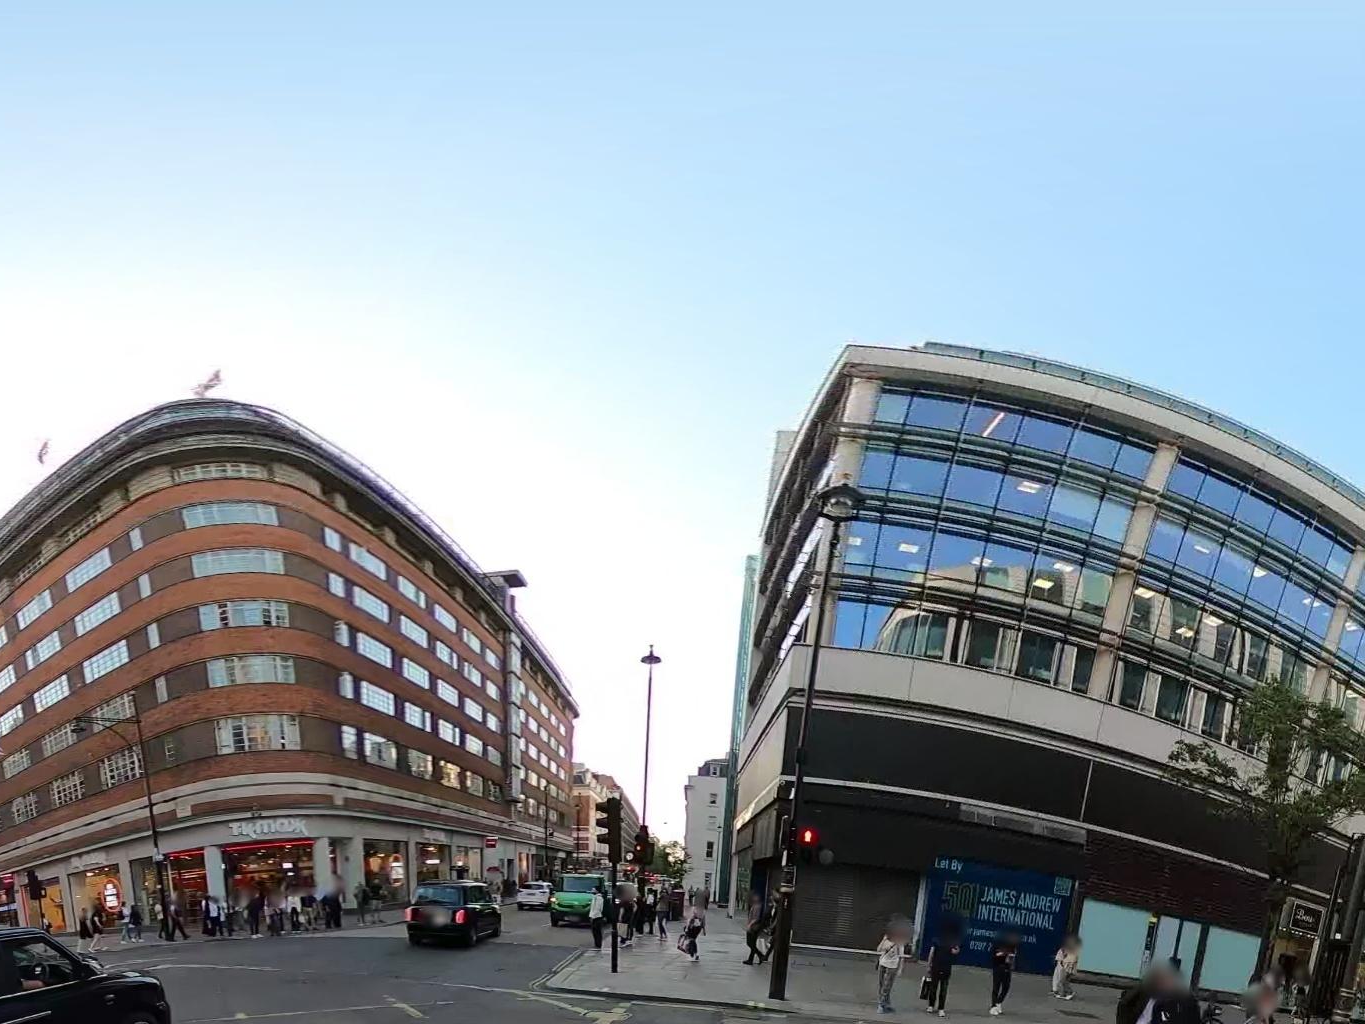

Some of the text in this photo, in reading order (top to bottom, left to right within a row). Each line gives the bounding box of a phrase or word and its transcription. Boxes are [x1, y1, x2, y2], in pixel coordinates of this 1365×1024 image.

[934, 857, 964, 873] Let By
[980, 886, 1062, 914] JAMES ANDREW
[977, 904, 1055, 930] INTERNATIONAL
